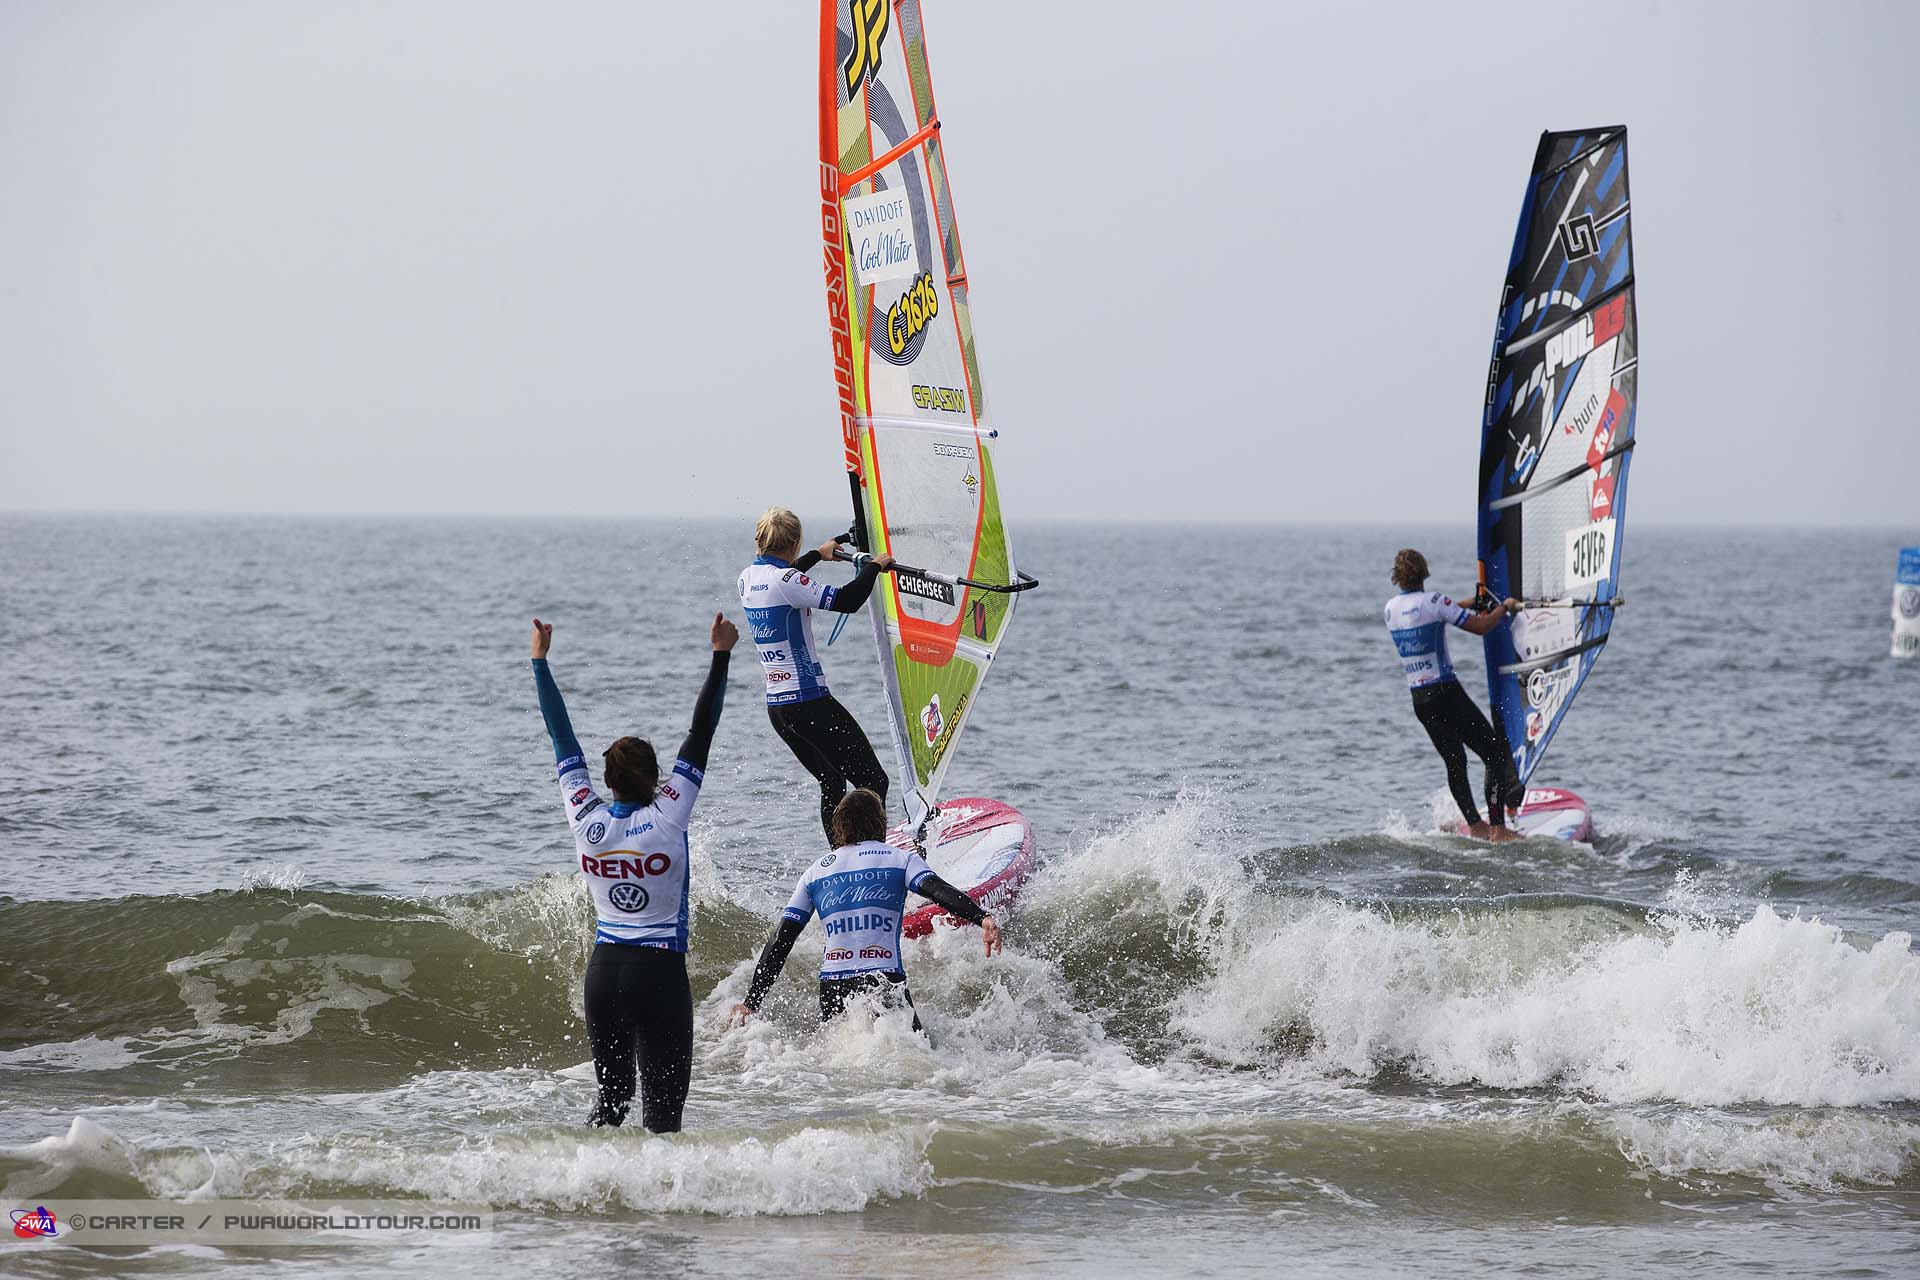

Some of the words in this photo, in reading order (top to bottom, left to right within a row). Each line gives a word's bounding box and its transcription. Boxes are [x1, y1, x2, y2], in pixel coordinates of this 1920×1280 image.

[854, 200, 904, 228] DAVIDOFF
[860, 231, 882, 271] Cool
[884, 228, 912, 266] Water
[820, 161, 863, 473] NEILPRYDE
[1573, 393, 1599, 434] burn
[1573, 530, 1606, 578] JEVER
[751, 584, 769, 592] PHILIPS
[899, 574, 944, 600] CHIEMSEE
[625, 821, 653, 838] PHILIPS
[582, 852, 671, 880] RENO
[822, 870, 891, 889] DAVIDOFF
[821, 886, 852, 911] Cool
[851, 884, 895, 903] Water
[826, 914, 893, 938] PHILIPS
[826, 950, 854, 960] RENO
[860, 949, 892, 959] RENO
